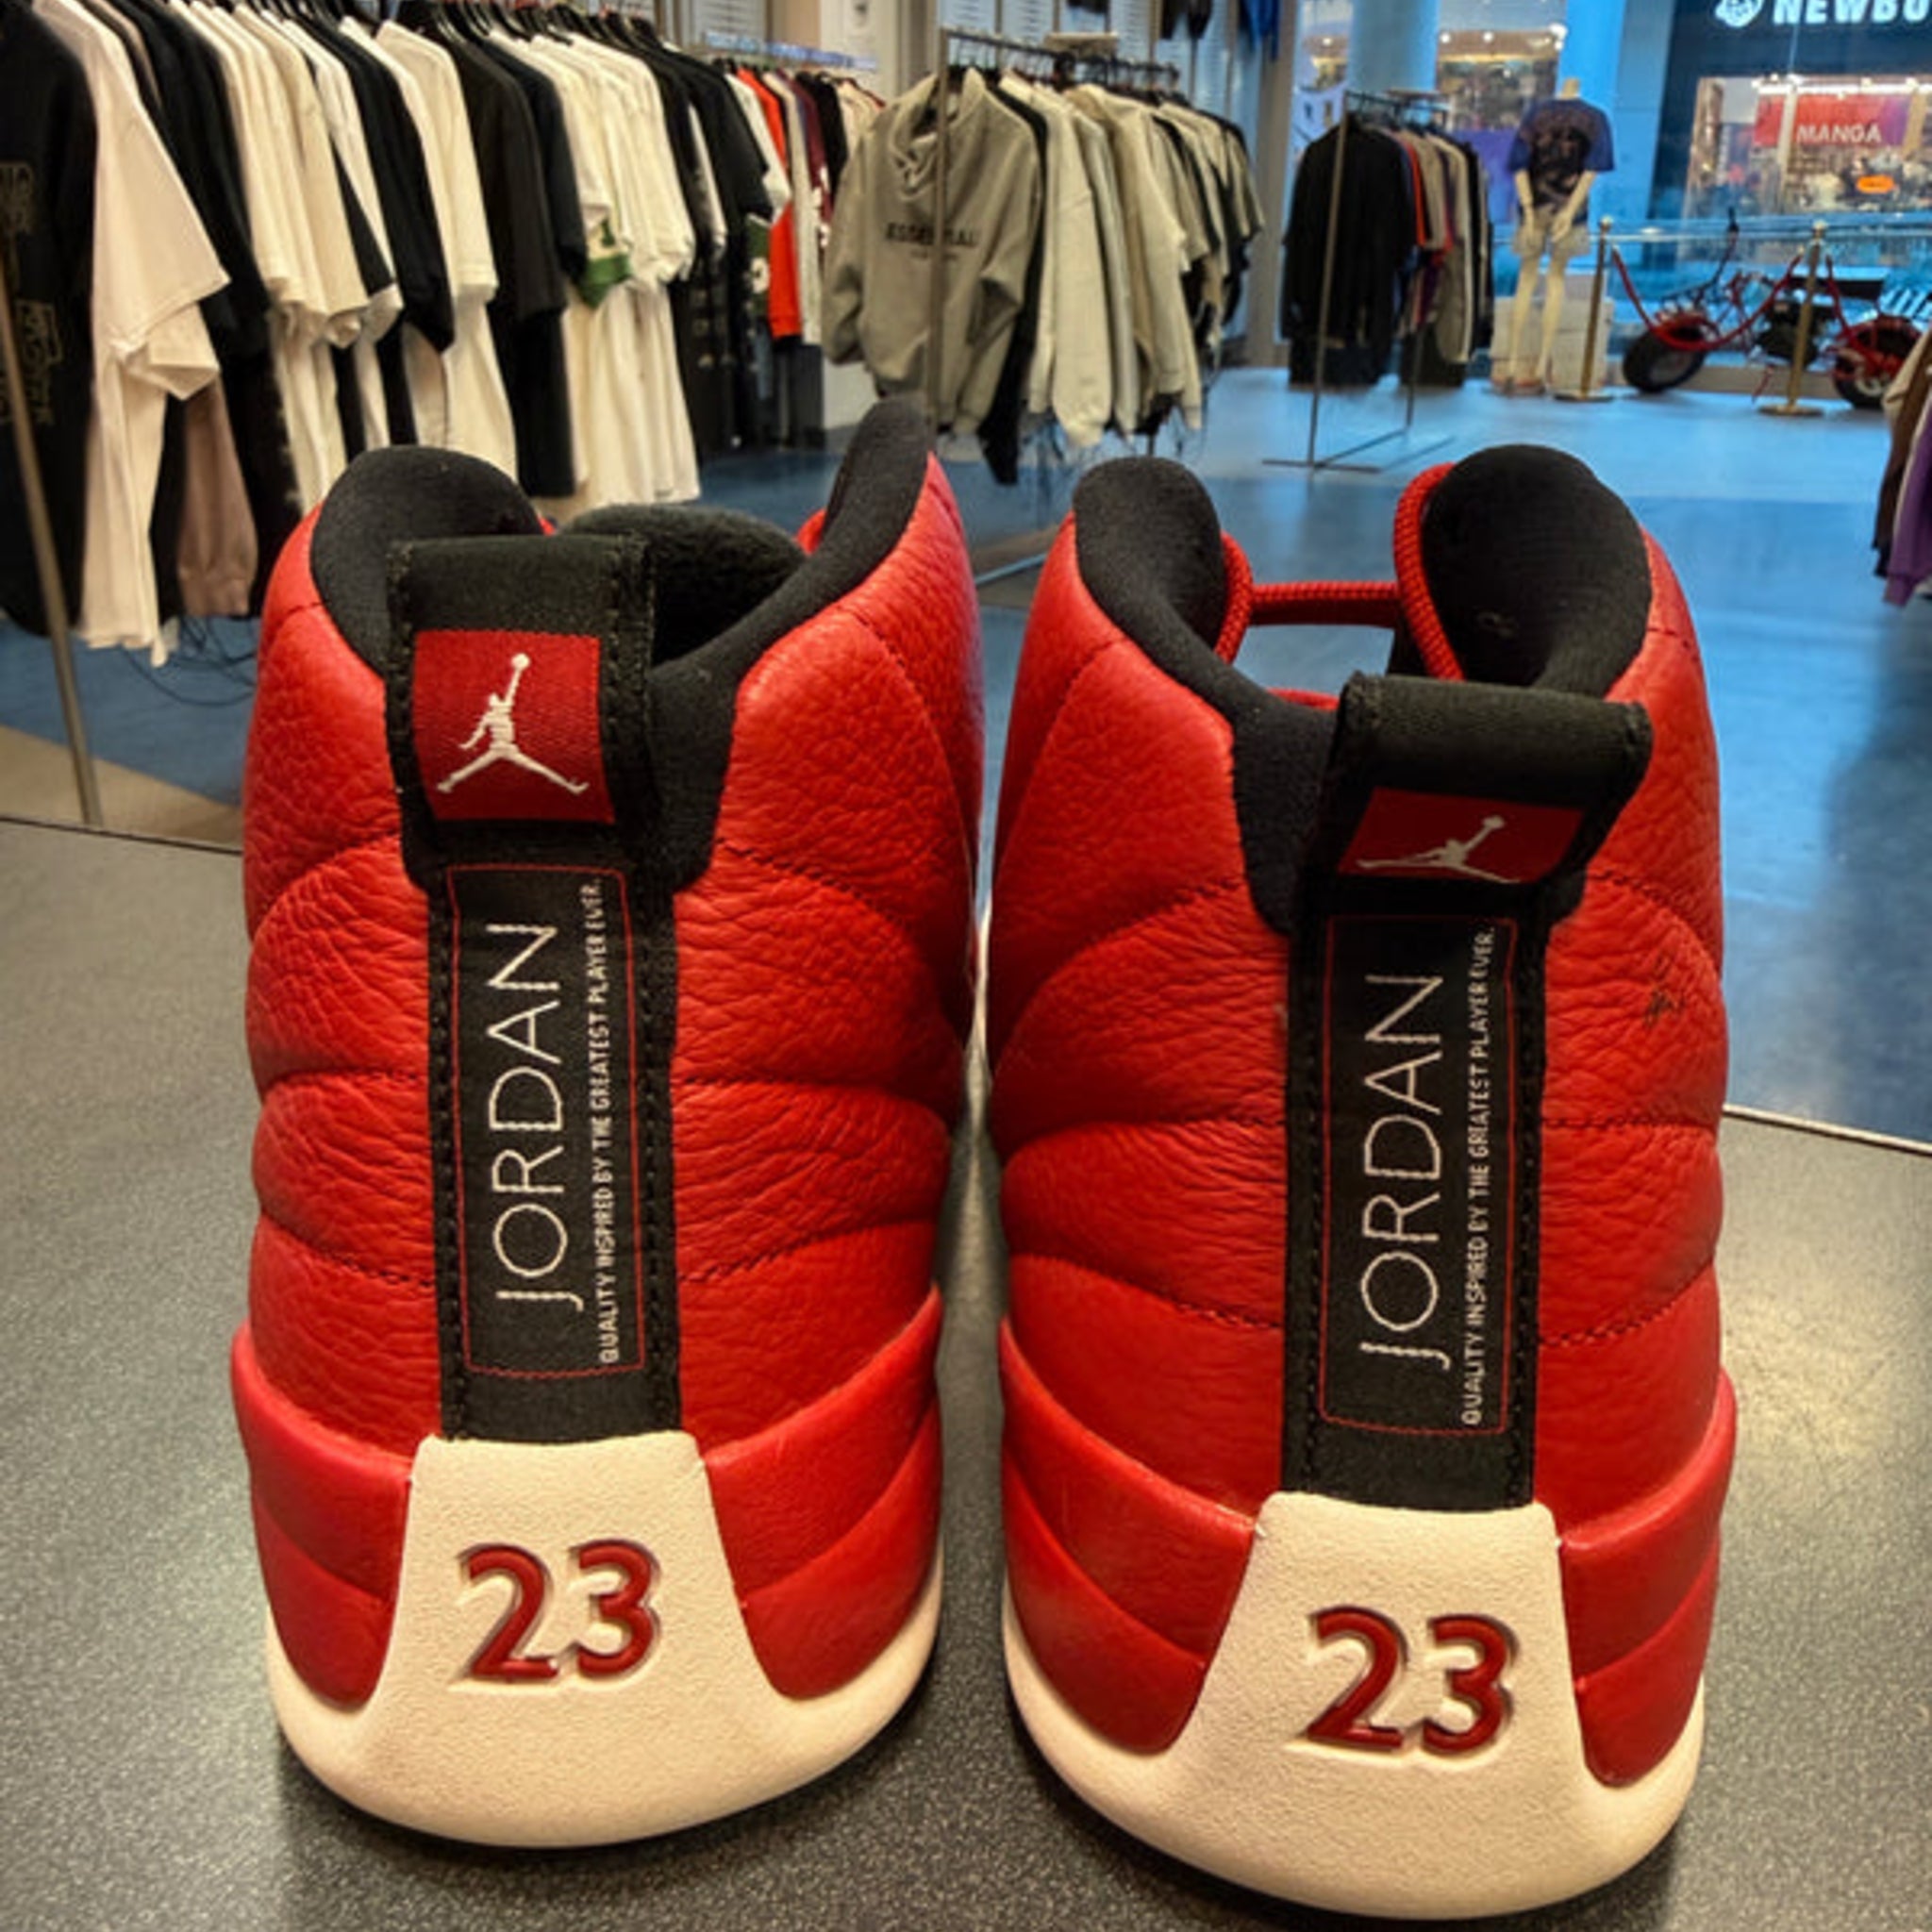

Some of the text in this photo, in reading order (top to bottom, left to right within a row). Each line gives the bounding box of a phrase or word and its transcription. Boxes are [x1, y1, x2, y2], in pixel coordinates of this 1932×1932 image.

[1796, 124, 1882, 142] MANGA
[585, 935, 609, 1004] PLAYER
[588, 1011, 612, 1110] GREATEST
[1468, 981, 1491, 1058] PLAYER
[486, 924, 584, 1312] JORDAN
[590, 1116, 612, 1150] THE
[1467, 1063, 1491, 1158] GREATEST
[591, 1157, 613, 1183] BY
[1359, 974, 1451, 1370] JORDAN
[1467, 1165, 1490, 1198] THE
[592, 1187, 616, 1267] INSPIRED
[1467, 1204, 1489, 1231] BY
[596, 1272, 620, 1364] QUALITY
[1464, 1236, 1489, 1325] INSPIRED
[1461, 1330, 1486, 1425] QUALITY
[456, 1538, 662, 1685] 23
[1298, 1605, 1520, 1758] 23
